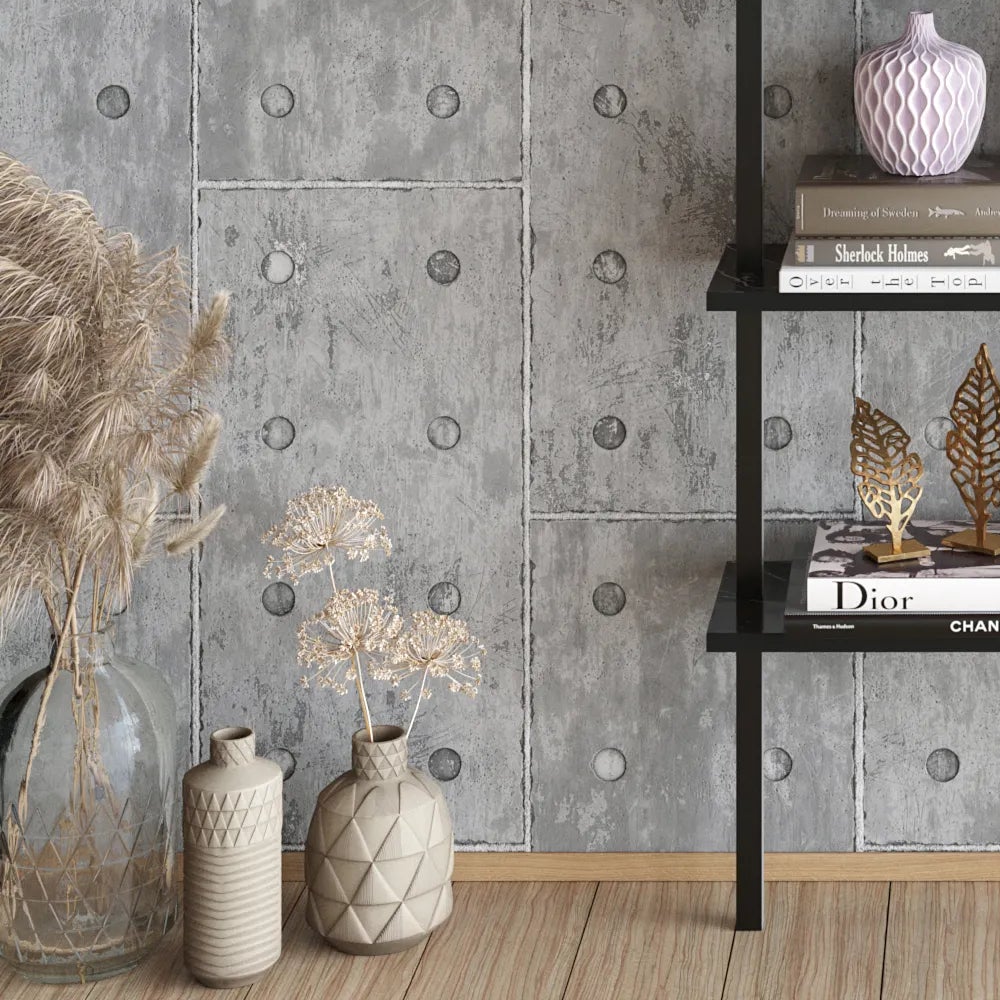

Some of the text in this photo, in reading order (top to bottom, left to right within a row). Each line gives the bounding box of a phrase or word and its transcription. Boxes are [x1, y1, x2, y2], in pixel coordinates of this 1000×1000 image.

[823, 207, 869, 220] Dreaming
[871, 207, 880, 218] of
[882, 207, 919, 218] Sweden
[835, 243, 884, 262] Sherlock
[887, 243, 929, 262] Holmes
[788, 276, 850, 288] Over
[871, 278, 914, 286] the
[931, 276, 983, 288] Top
[831, 580, 914, 611] Dior
